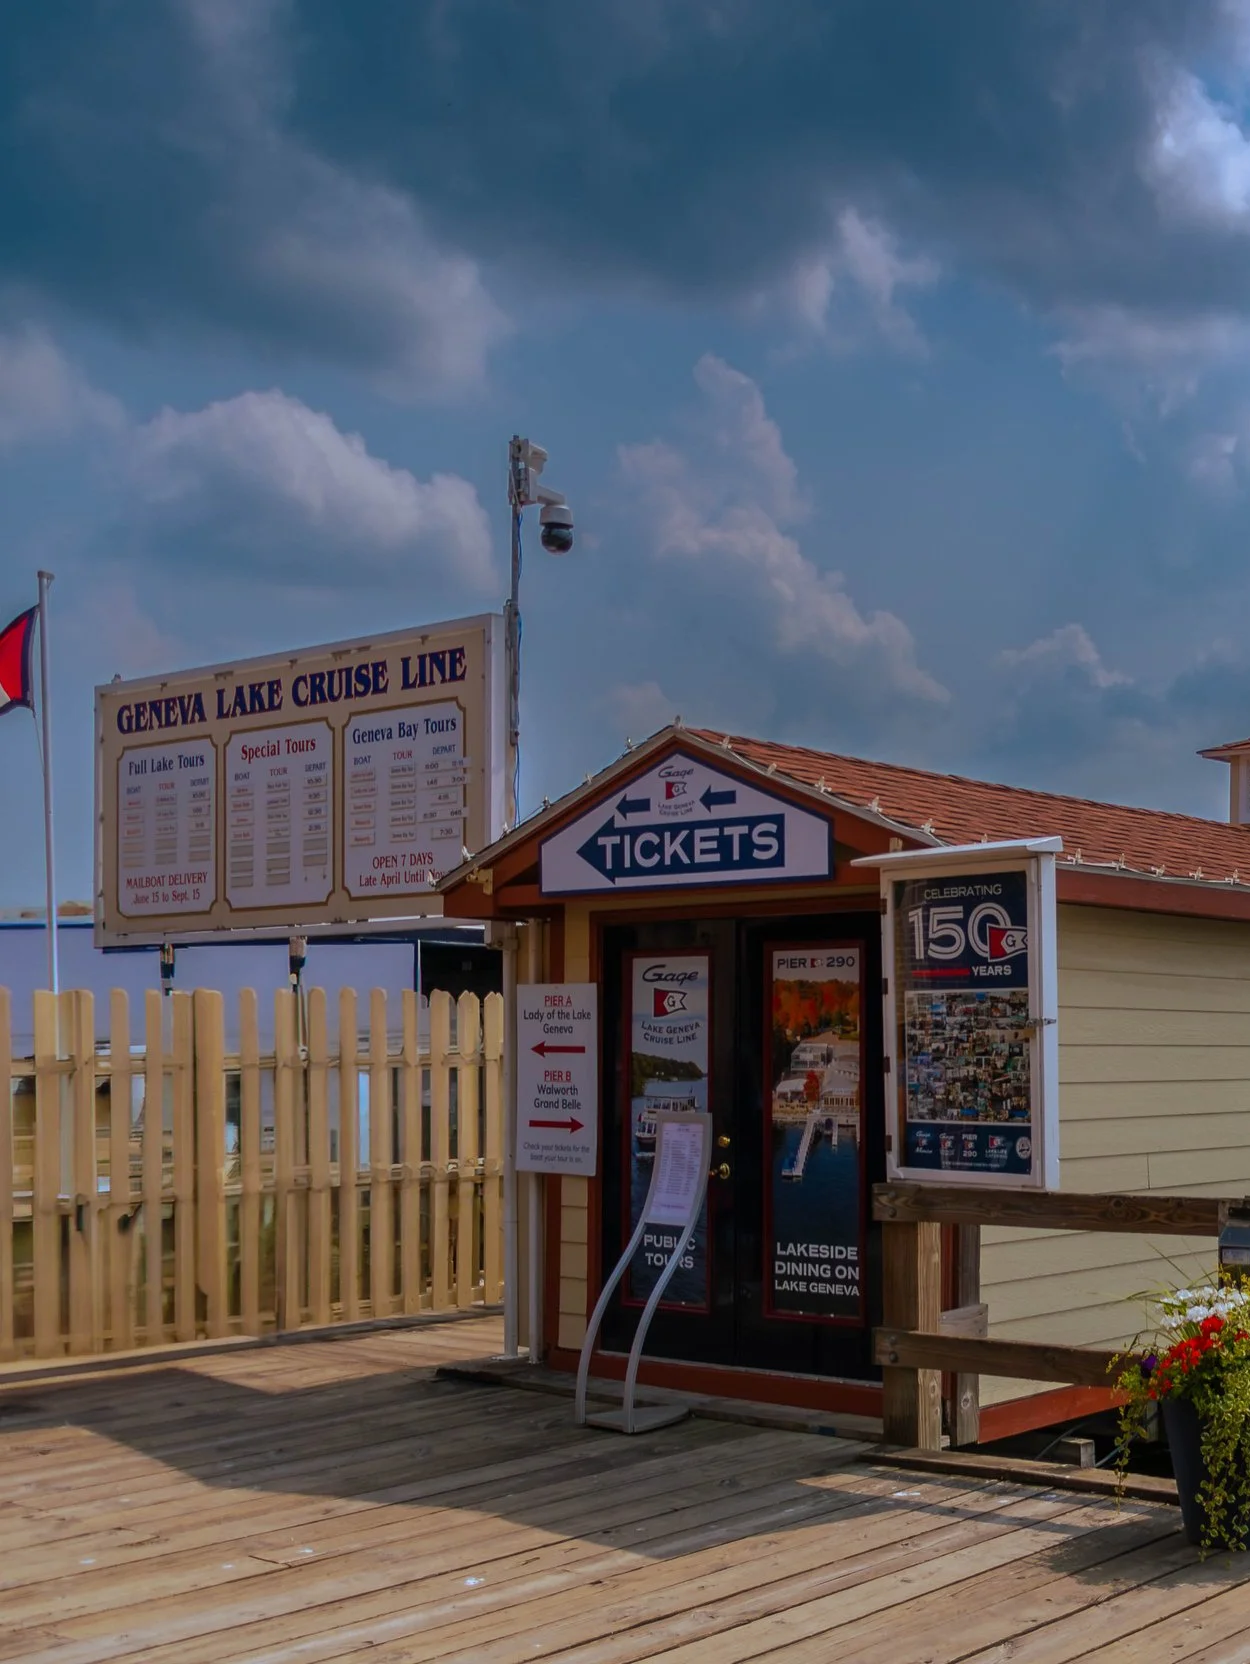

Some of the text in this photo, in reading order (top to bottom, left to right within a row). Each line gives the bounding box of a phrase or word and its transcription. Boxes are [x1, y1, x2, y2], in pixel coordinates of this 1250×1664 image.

[116, 646, 467, 735] GENEVA LAKE CRUISE LINE
[352, 717, 457, 744] Geneva Bay Tours
[241, 738, 316, 764] Special Tours
[353, 744, 456, 766] BOAT TOUR DEPART
[128, 754, 205, 776] Full Lake Tours
[234, 761, 327, 781] BOAT TOUR DEPART
[658, 765, 695, 780] Gage
[158, 782, 175, 791] TOUR
[597, 822, 780, 870] TICKETS
[372, 852, 433, 869] OPEN 7 DAYS
[126, 871, 208, 889] MAILBOAT DELIVERY
[359, 875, 377, 887] Late
[379, 871, 401, 888] April
[404, 870, 425, 884] Until
[132, 888, 201, 905] June 15 to Sept. 15
[924, 884, 1002, 900] CELEBRATING
[908, 902, 1012, 960] 150
[1005, 934, 1017, 948] G
[777, 956, 856, 969] PIER 290
[972, 965, 1012, 977] YEARS
[642, 964, 699, 986] Gage
[544, 995, 573, 1007] PIER A
[667, 995, 676, 1007] G
[523, 1009, 591, 1023] Lady of the Lake
[543, 1023, 573, 1034] Geneva
[641, 1020, 701, 1034] LAKE GENEVA
[643, 1032, 697, 1045] CRUISE LINE
[544, 1070, 572, 1082] PIER B
[536, 1084, 578, 1096] Walworth
[533, 1098, 582, 1110] Grand Belle
[644, 1234, 696, 1251] PUBLC
[776, 1241, 858, 1260] LAKESIDE
[775, 1261, 860, 1280] DINING ON
[775, 1279, 860, 1297] LAKE GENEVA
